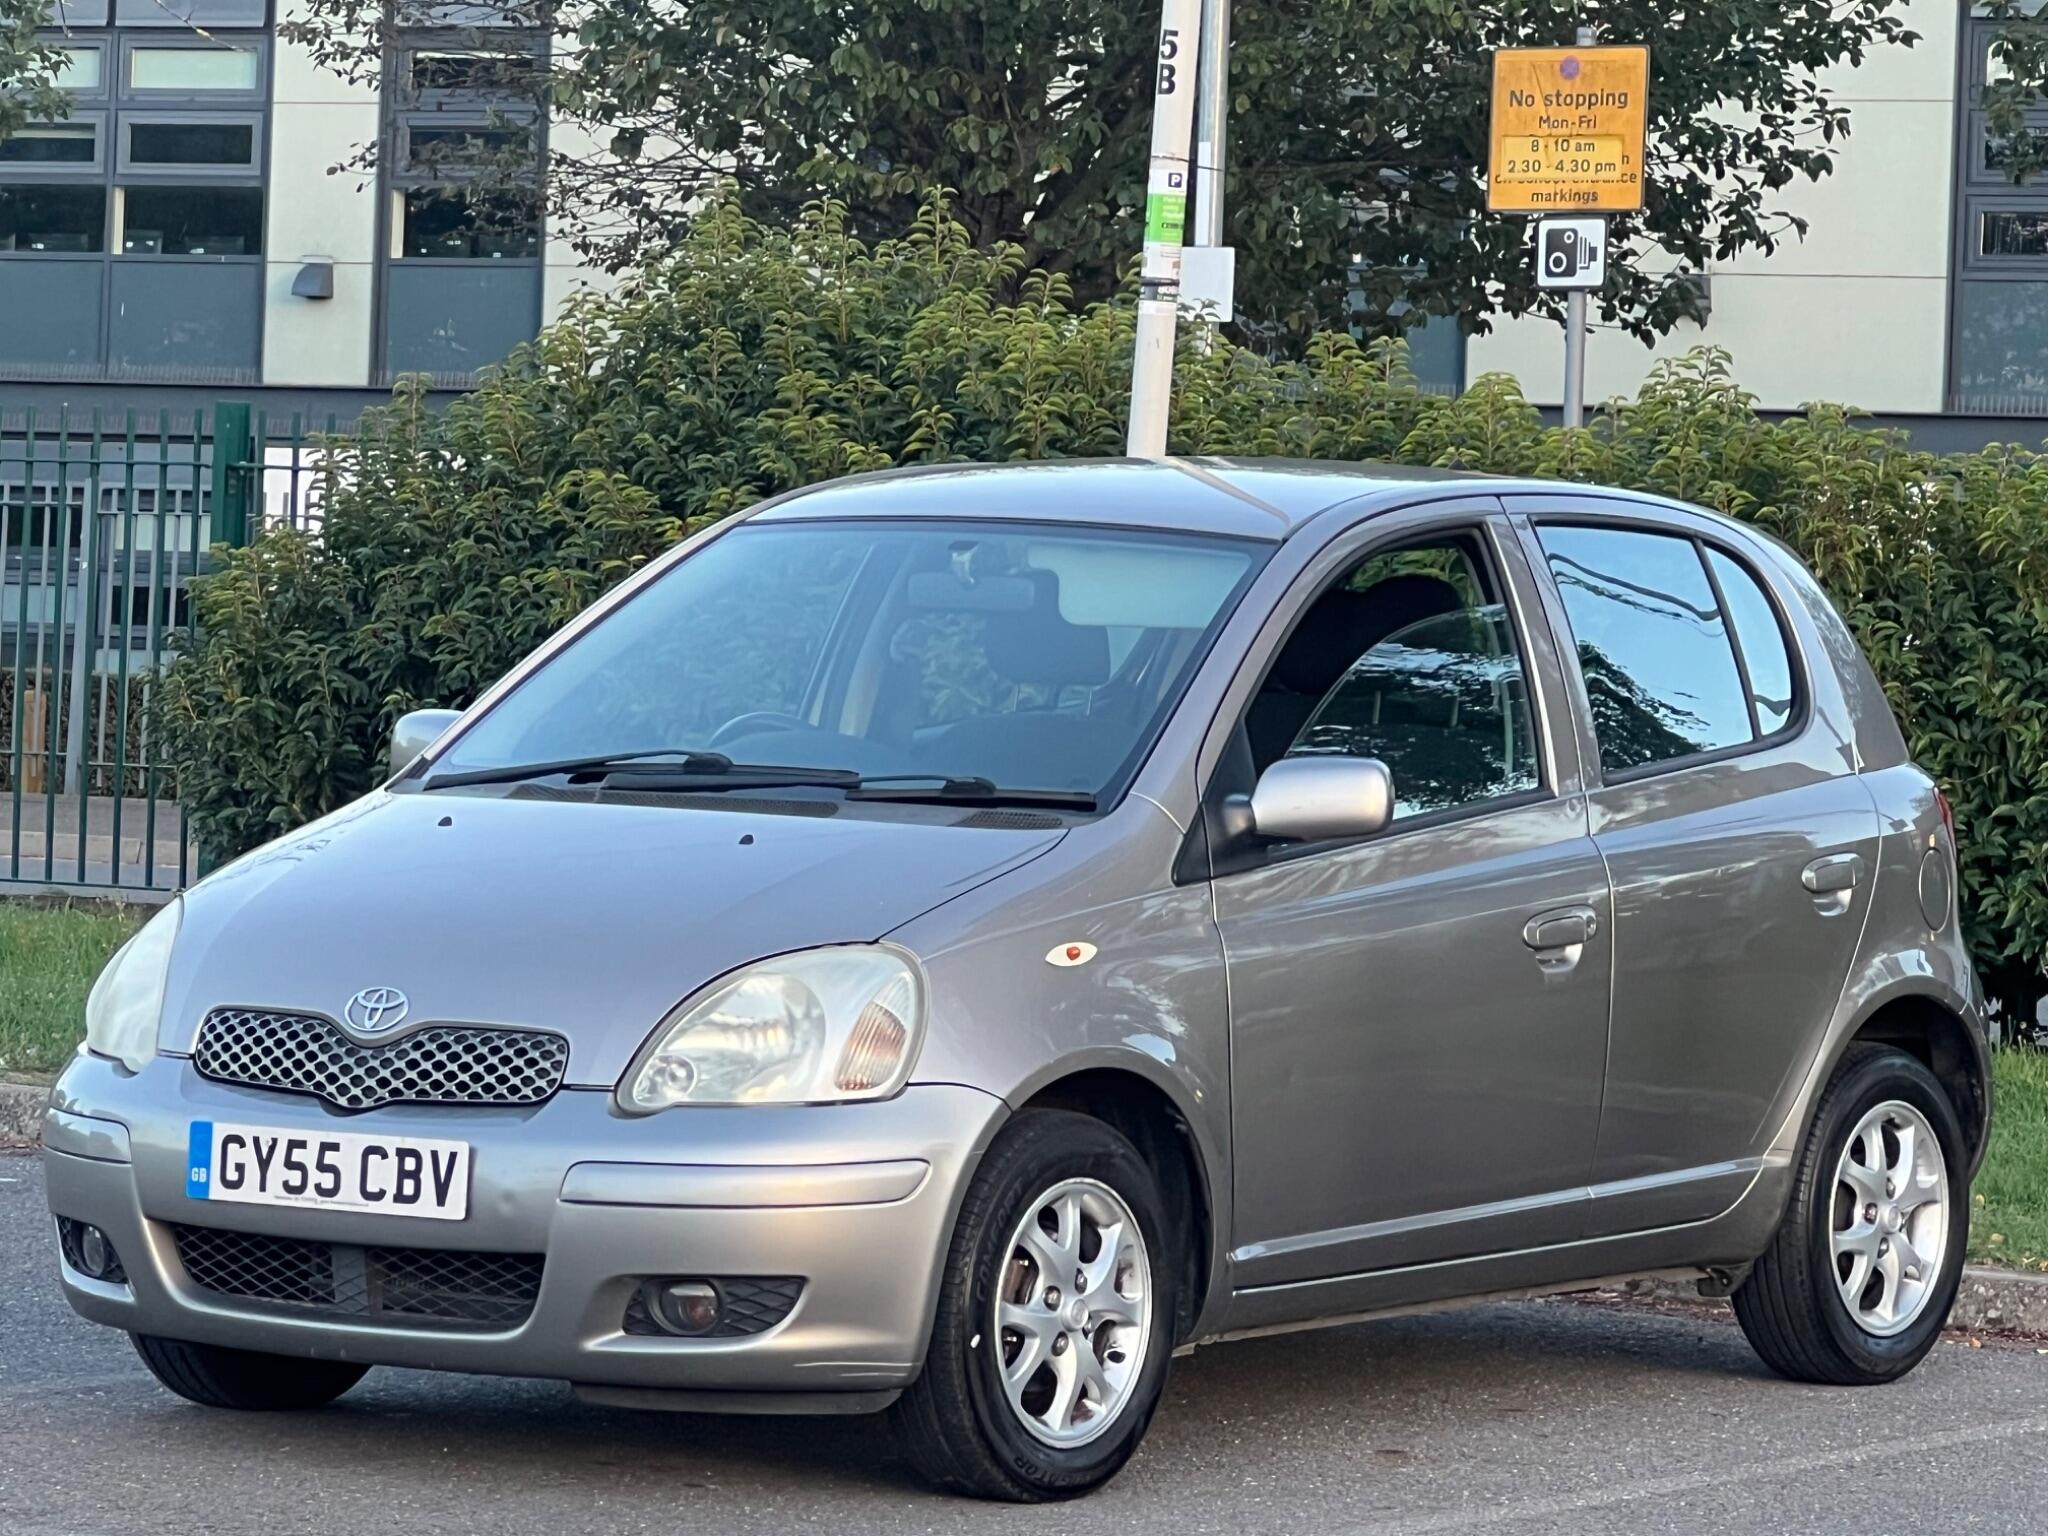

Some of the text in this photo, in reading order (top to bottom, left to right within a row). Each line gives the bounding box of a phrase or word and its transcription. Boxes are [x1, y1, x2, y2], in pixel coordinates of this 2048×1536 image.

[1509, 88, 1629, 110] No stopping
[1531, 139, 1540, 153] 8
[1553, 139, 1570, 152] 10
[1574, 142, 1595, 152] am
[1507, 159, 1541, 174] 2.30
[1555, 159, 1591, 173] 4.30
[1594, 162, 1617, 175] pm
[1531, 188, 1599, 204] markings
[191, 1167, 207, 1183] GB
[219, 1134, 459, 1208] GY55 CBV
